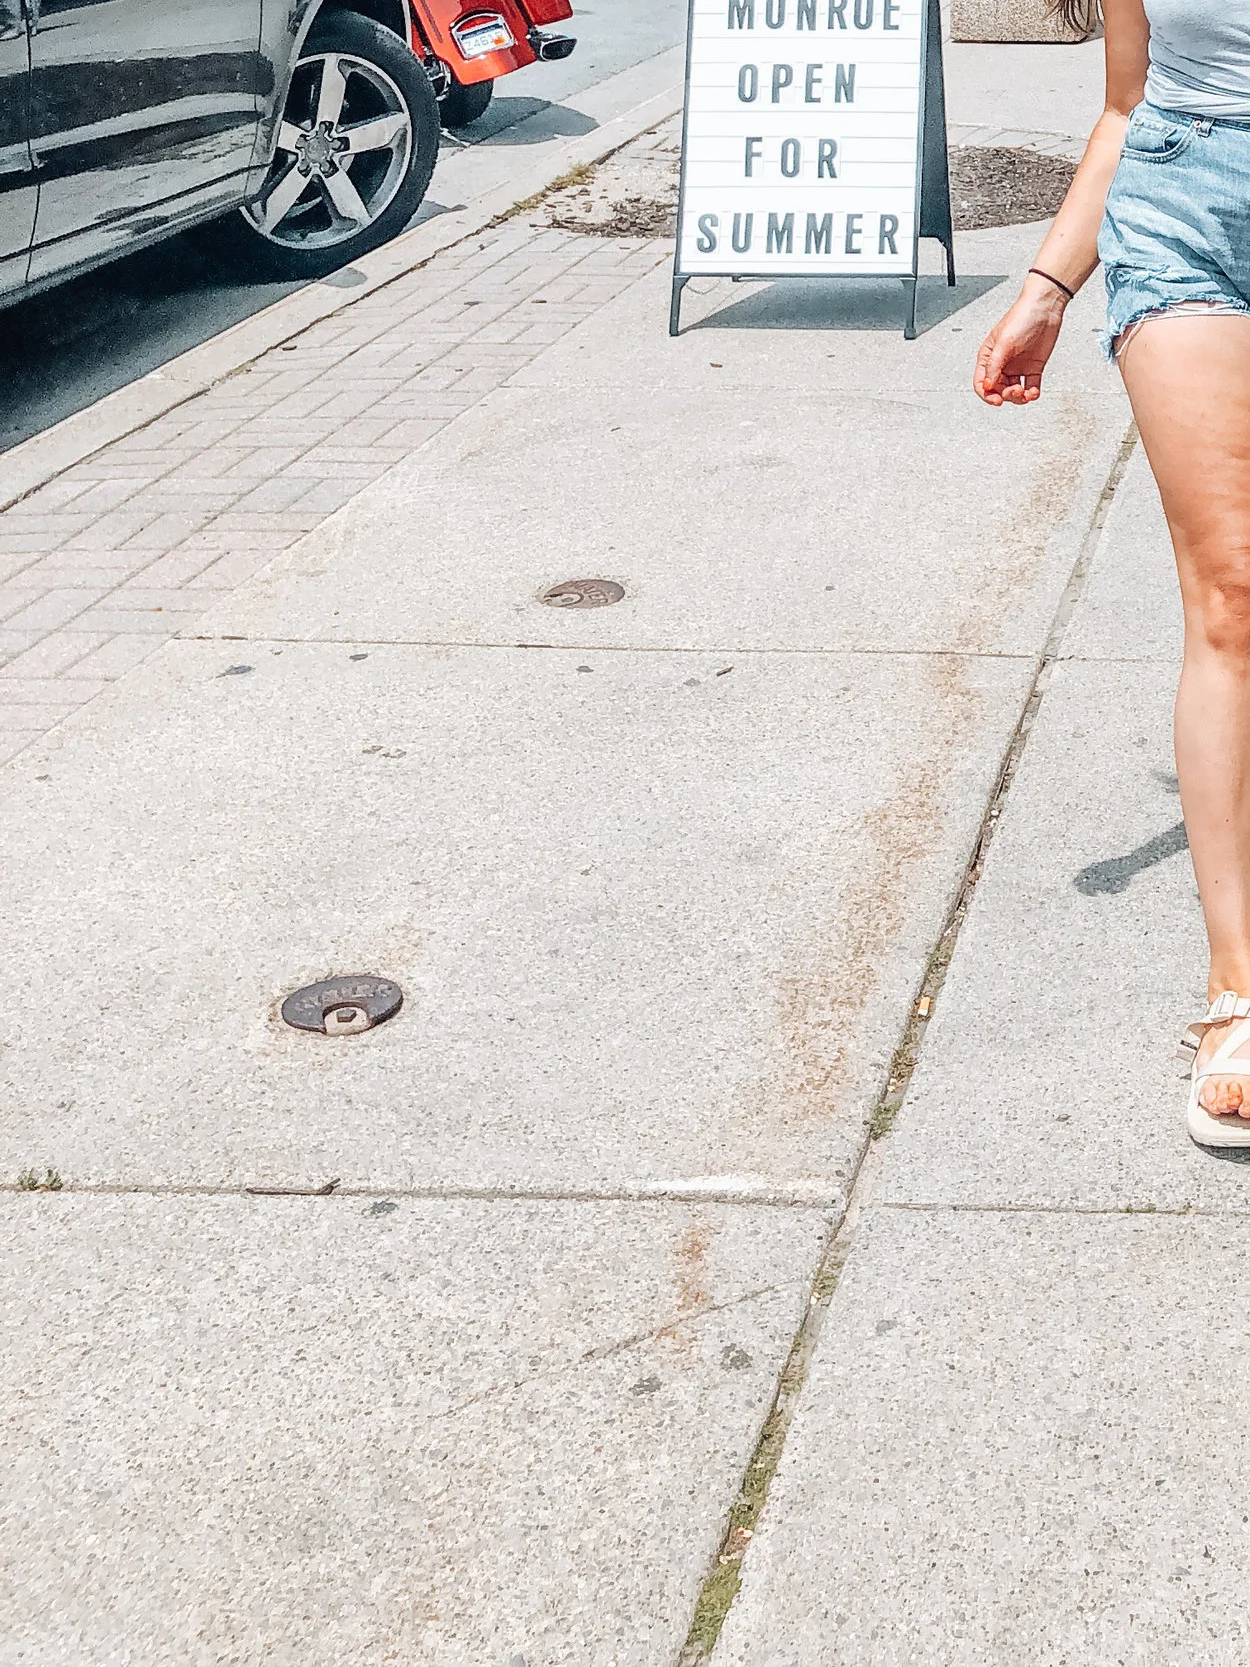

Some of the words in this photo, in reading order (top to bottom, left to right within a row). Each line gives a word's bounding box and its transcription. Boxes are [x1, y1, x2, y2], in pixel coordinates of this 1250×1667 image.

[737, 63, 857, 103] OPEN
[744, 136, 838, 179] FOR
[696, 212, 900, 255] SUMMER
